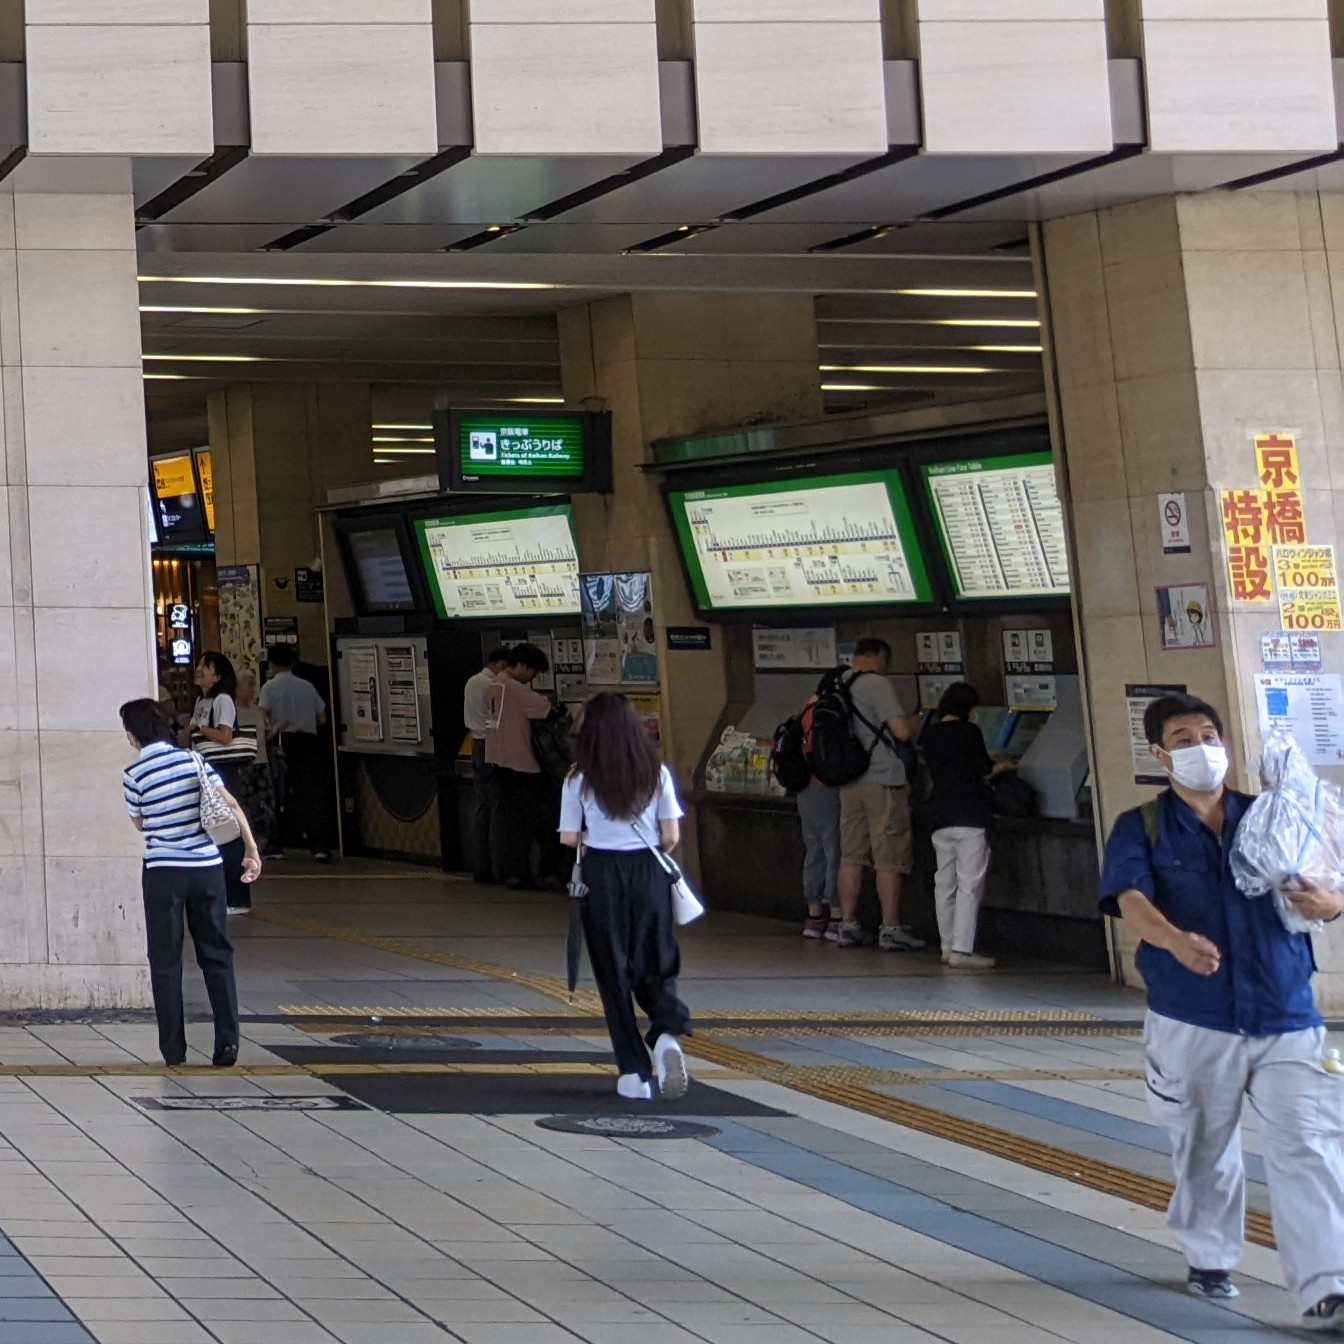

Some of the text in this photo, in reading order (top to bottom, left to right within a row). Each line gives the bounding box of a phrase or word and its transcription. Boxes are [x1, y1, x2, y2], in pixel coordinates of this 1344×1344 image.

[500, 439, 563, 451] きっぷうりば
[1256, 434, 1306, 545] 京橋
[1223, 490, 1272, 601] 特設
